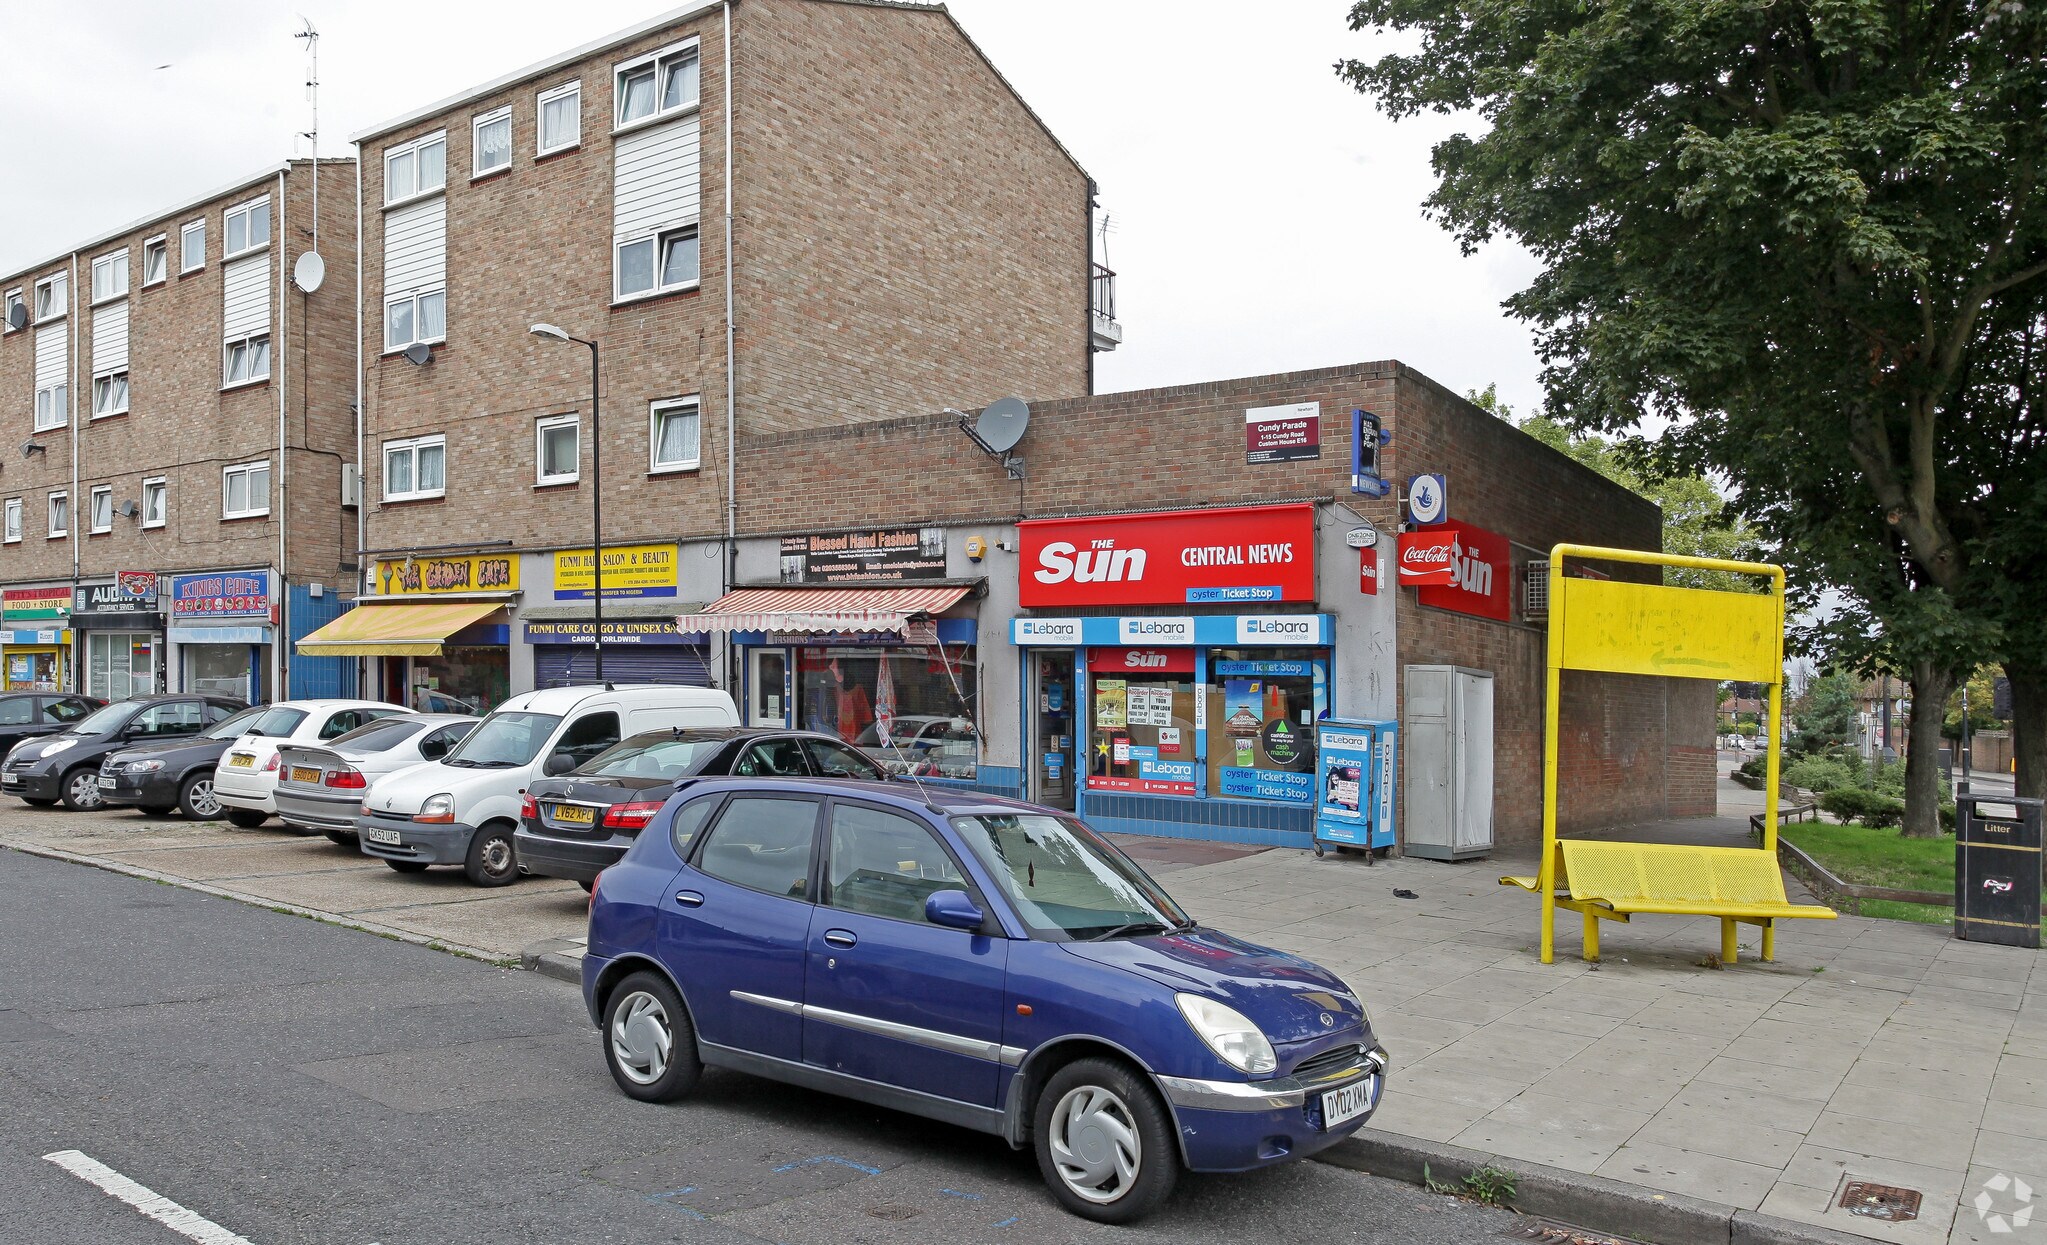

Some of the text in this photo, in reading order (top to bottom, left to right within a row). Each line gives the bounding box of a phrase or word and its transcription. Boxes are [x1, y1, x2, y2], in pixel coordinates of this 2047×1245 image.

[1257, 421, 1307, 432] Cundy Parade
[810, 531, 918, 551] Blessed Hand Fashion
[1091, 539, 1114, 549] THE
[560, 551, 670, 568] FUNMI HAI SALON & BEAUTY
[1181, 543, 1293, 567] CENTRAL NEWS
[1468, 546, 1480, 559] THE
[1033, 541, 1147, 584] Sun
[1447, 541, 1493, 596] Sun
[426, 560, 471, 590] GARDEN
[477, 559, 510, 588] CAFE
[1362, 564, 1376, 578] Sun
[34, 588, 70, 598] TROPICAL
[181, 577, 260, 599] KINGS CAFE
[1192, 587, 1274, 600] oyster Ticket Stop
[12, 600, 64, 609] FOOD STORE
[529, 625, 555, 634] FUNMI
[557, 624, 579, 633] CARE
[582, 624, 614, 634] CAGO
[616, 624, 625, 633] &
[627, 624, 662, 634] UNISEX
[1033, 621, 1074, 635] Lebara
[1137, 620, 1185, 634] Lebara
[1259, 619, 1309, 633] Lebara
[571, 635, 596, 643] CARGO
[1284, 633, 1308, 641] mobile
[1124, 650, 1168, 667] Sun
[1221, 662, 1302, 674] oyster Ticket Stop
[1333, 736, 1363, 746] Lebara
[1152, 761, 1191, 775] Lebara
[1333, 756, 1362, 767] Lebara
[1225, 769, 1308, 786] oyster Ticket Stop
[1382, 744, 1391, 804] Lebara
[1226, 783, 1309, 800] oyster Ticket Stop
[555, 805, 593, 820] LV62 XPC
[1984, 823, 2011, 834] Litter
[1327, 1083, 1369, 1120] DY02 XMA
